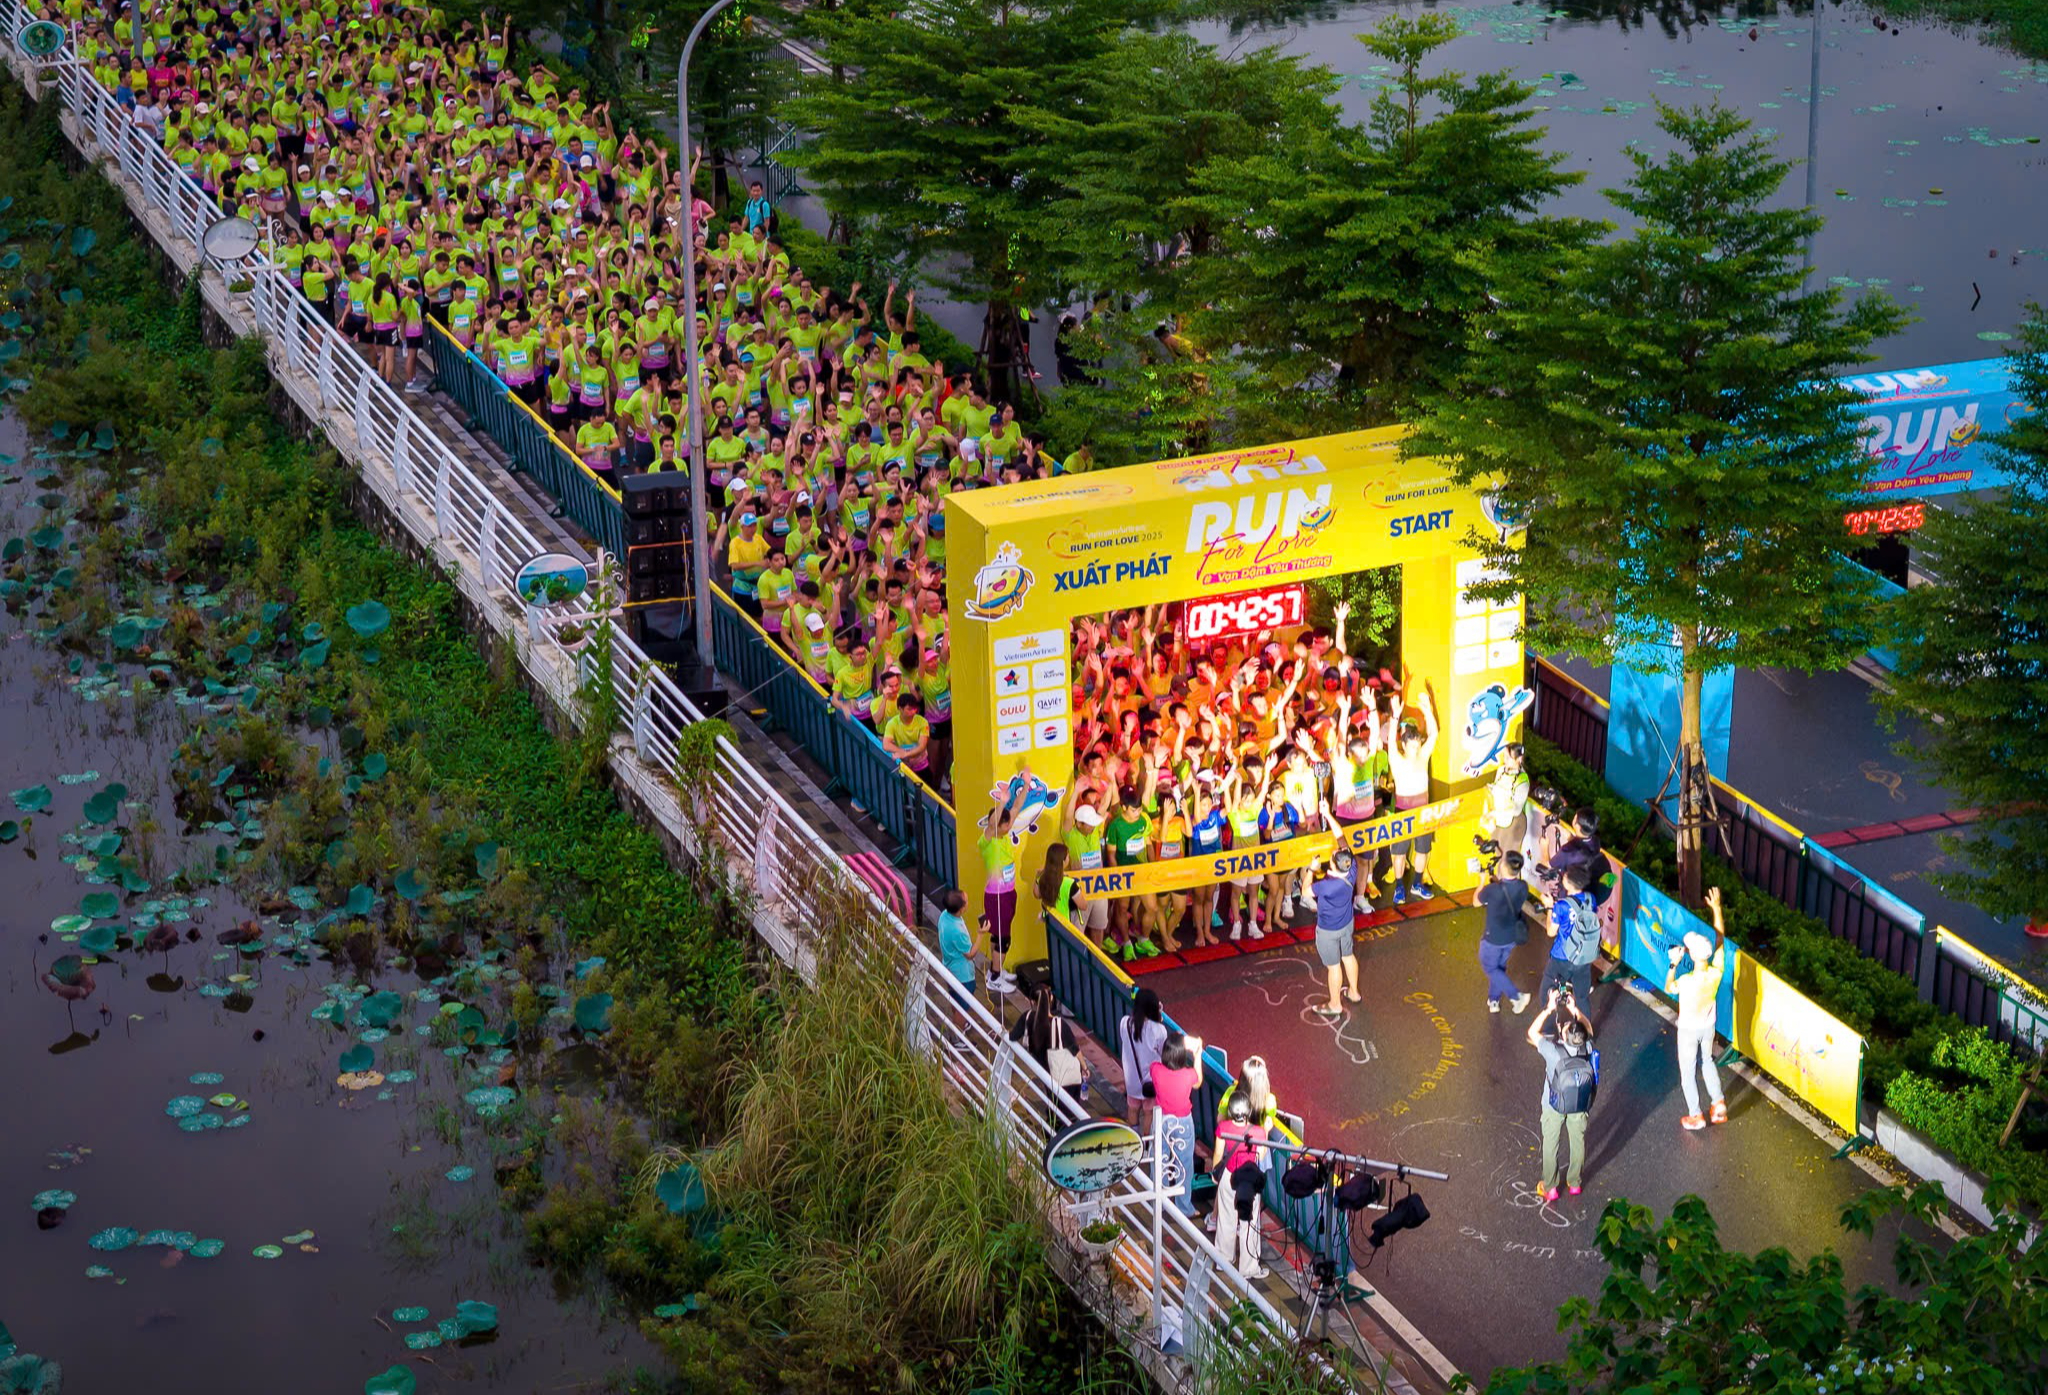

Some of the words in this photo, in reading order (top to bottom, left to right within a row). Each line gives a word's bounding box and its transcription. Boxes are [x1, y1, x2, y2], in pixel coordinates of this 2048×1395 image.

[1852, 403, 1979, 458] RUN
[1906, 438, 1962, 475] Love
[1385, 492, 1406, 503] RUN
[1408, 489, 1425, 500] FOR
[1427, 485, 1450, 496] LOVE
[1185, 484, 1332, 553] RUN
[1390, 508, 1454, 537] START
[1070, 542, 1092, 553] RUN
[1094, 538, 1113, 550] FOR
[1115, 534, 1140, 546] LOVE
[1142, 531, 1163, 542] 2025
[1196, 532, 1247, 580] For
[1254, 524, 1318, 564] Love
[1054, 558, 1111, 593] XUẤT
[1116, 552, 1172, 582] PHÁT
[1188, 589, 1302, 639] 00:42:57
[1000, 704, 1026, 717] GULU
[1073, 871, 1135, 894] TART
[1213, 848, 1280, 876] START
[1352, 815, 1415, 848] START
